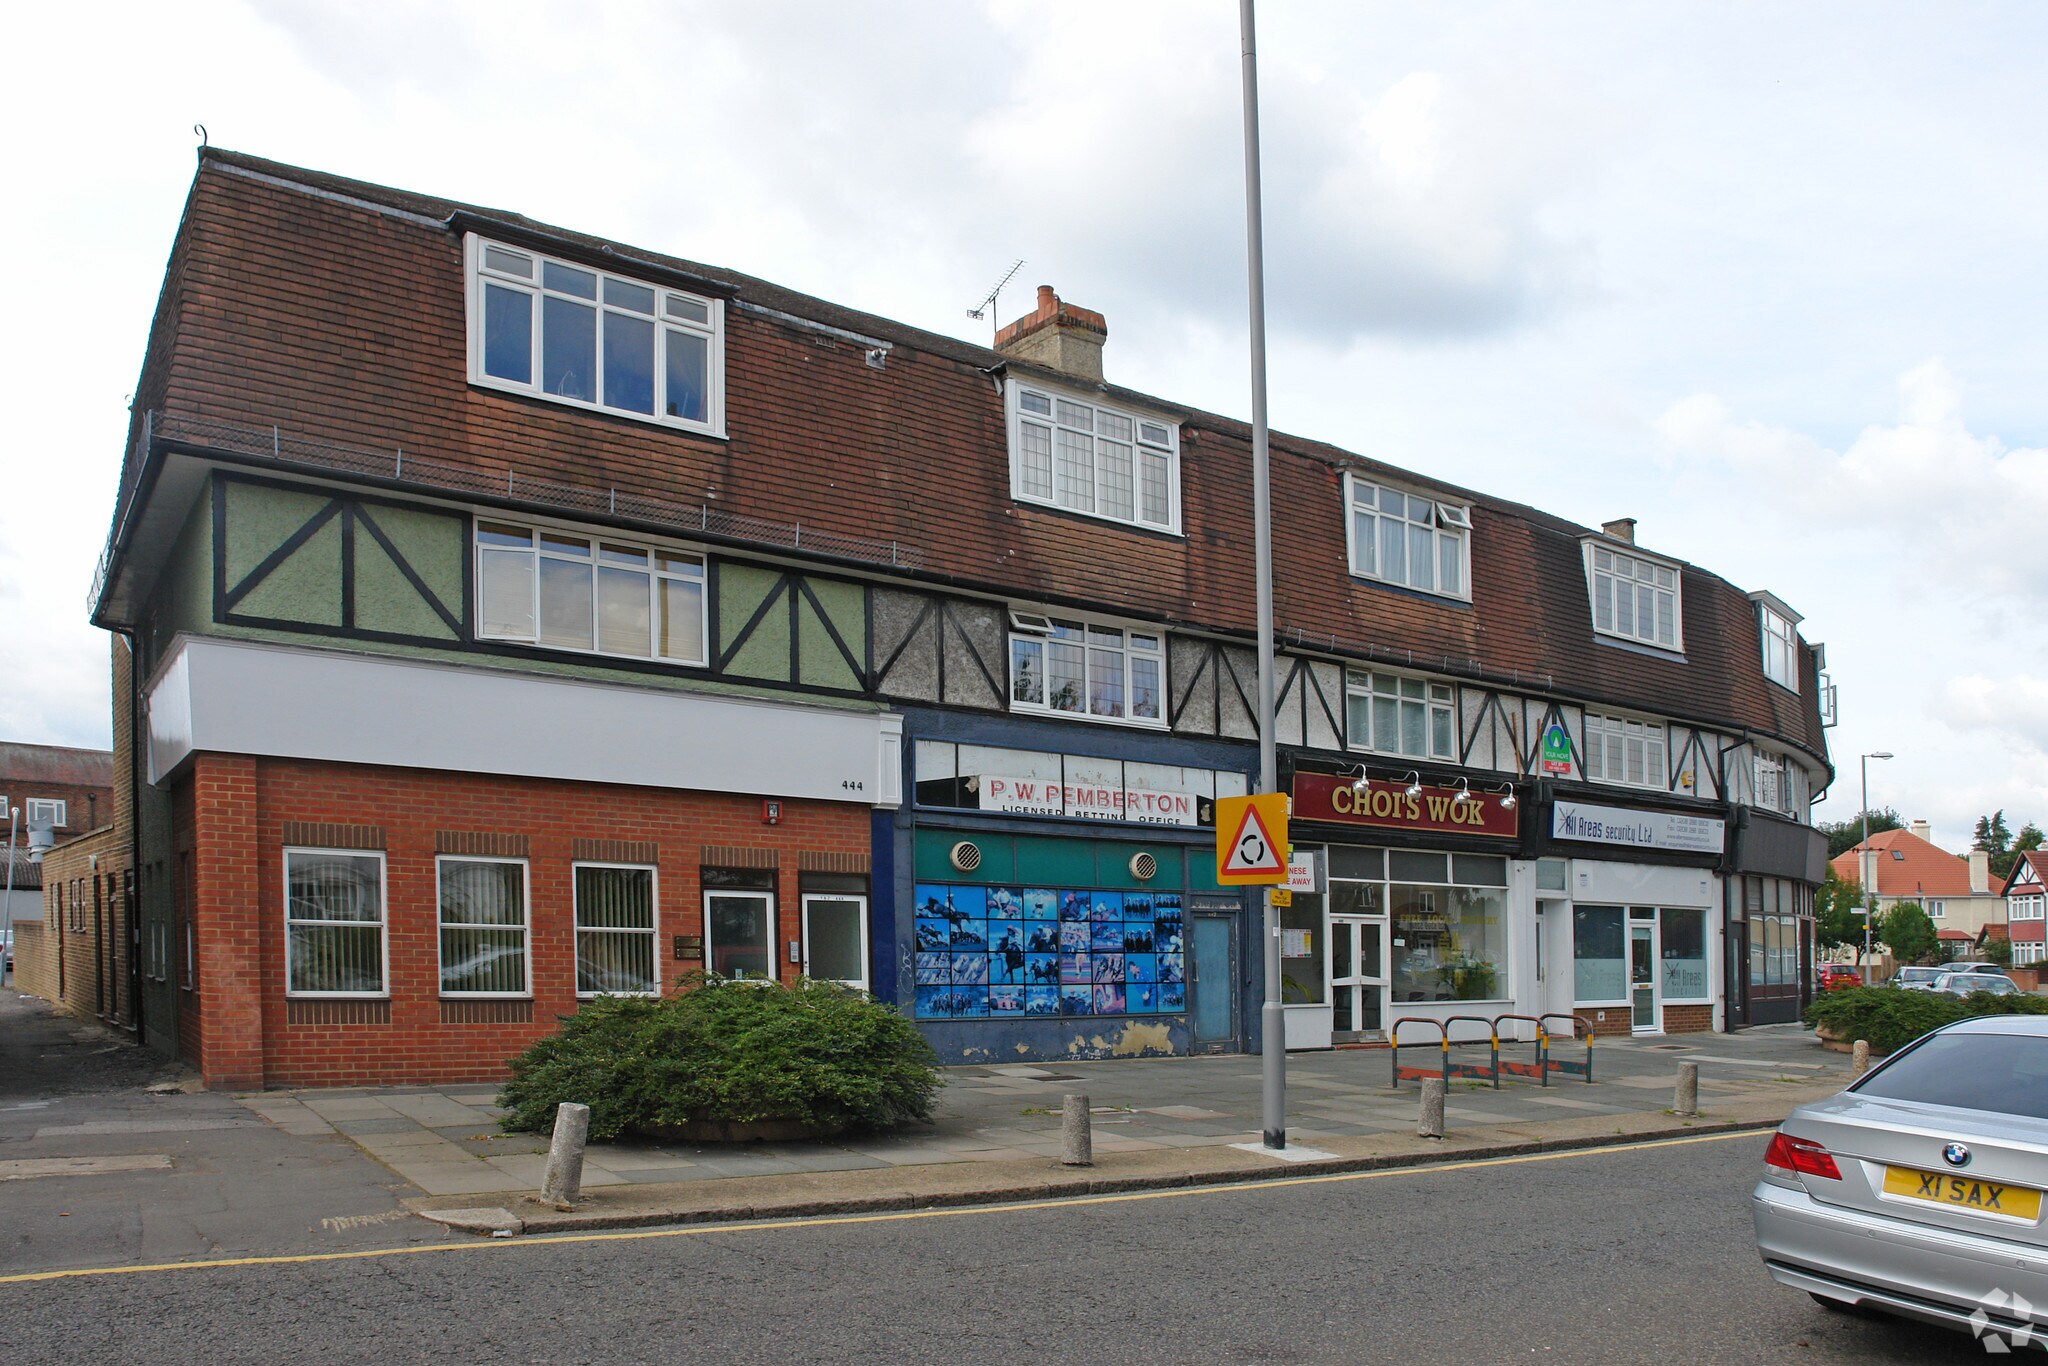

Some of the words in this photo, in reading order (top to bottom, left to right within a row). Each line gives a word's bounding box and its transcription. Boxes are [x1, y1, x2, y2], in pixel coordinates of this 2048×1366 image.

[842, 780, 863, 791] 444
[1002, 804, 1062, 816] LICENSED
[1046, 784, 1191, 816] PEMBERTON
[1331, 785, 1421, 821] CHOI'S
[1426, 795, 1485, 826] WOK
[1579, 816, 1603, 839] Areas
[1605, 824, 1636, 844] security
[1638, 823, 1653, 843] Ltd
[1288, 867, 1307, 875] NESE
[1292, 877, 1312, 886] AWAY
[1949, 1179, 2004, 1209] SAX
